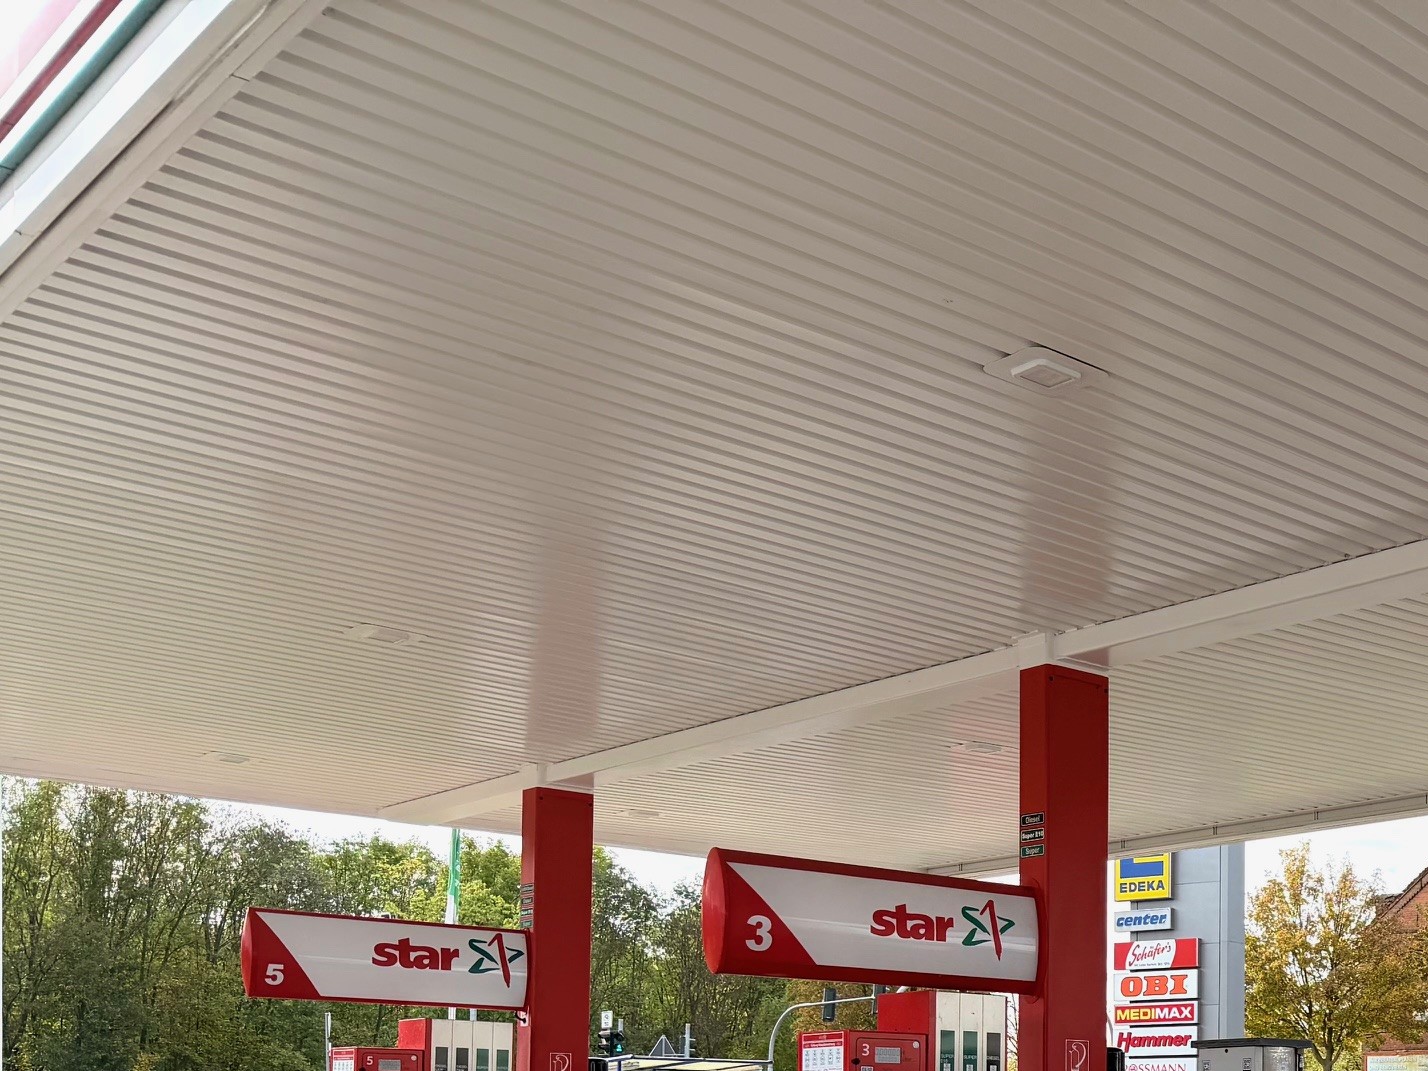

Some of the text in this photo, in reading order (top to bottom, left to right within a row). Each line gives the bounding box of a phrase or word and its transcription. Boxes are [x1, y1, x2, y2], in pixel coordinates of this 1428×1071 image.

[1119, 880, 1166, 894] EDEKA
[870, 904, 954, 943] star
[1116, 913, 1168, 928] center
[745, 915, 773, 951] 3
[371, 937, 460, 972] star
[264, 963, 284, 986] 5
[1120, 974, 1188, 997] OBI
[1116, 1006, 1193, 1021] MEDIMAX
[861, 1043, 870, 1056] 3
[1117, 1032, 1192, 1053] Hammer
[366, 1055, 374, 1066] 5
